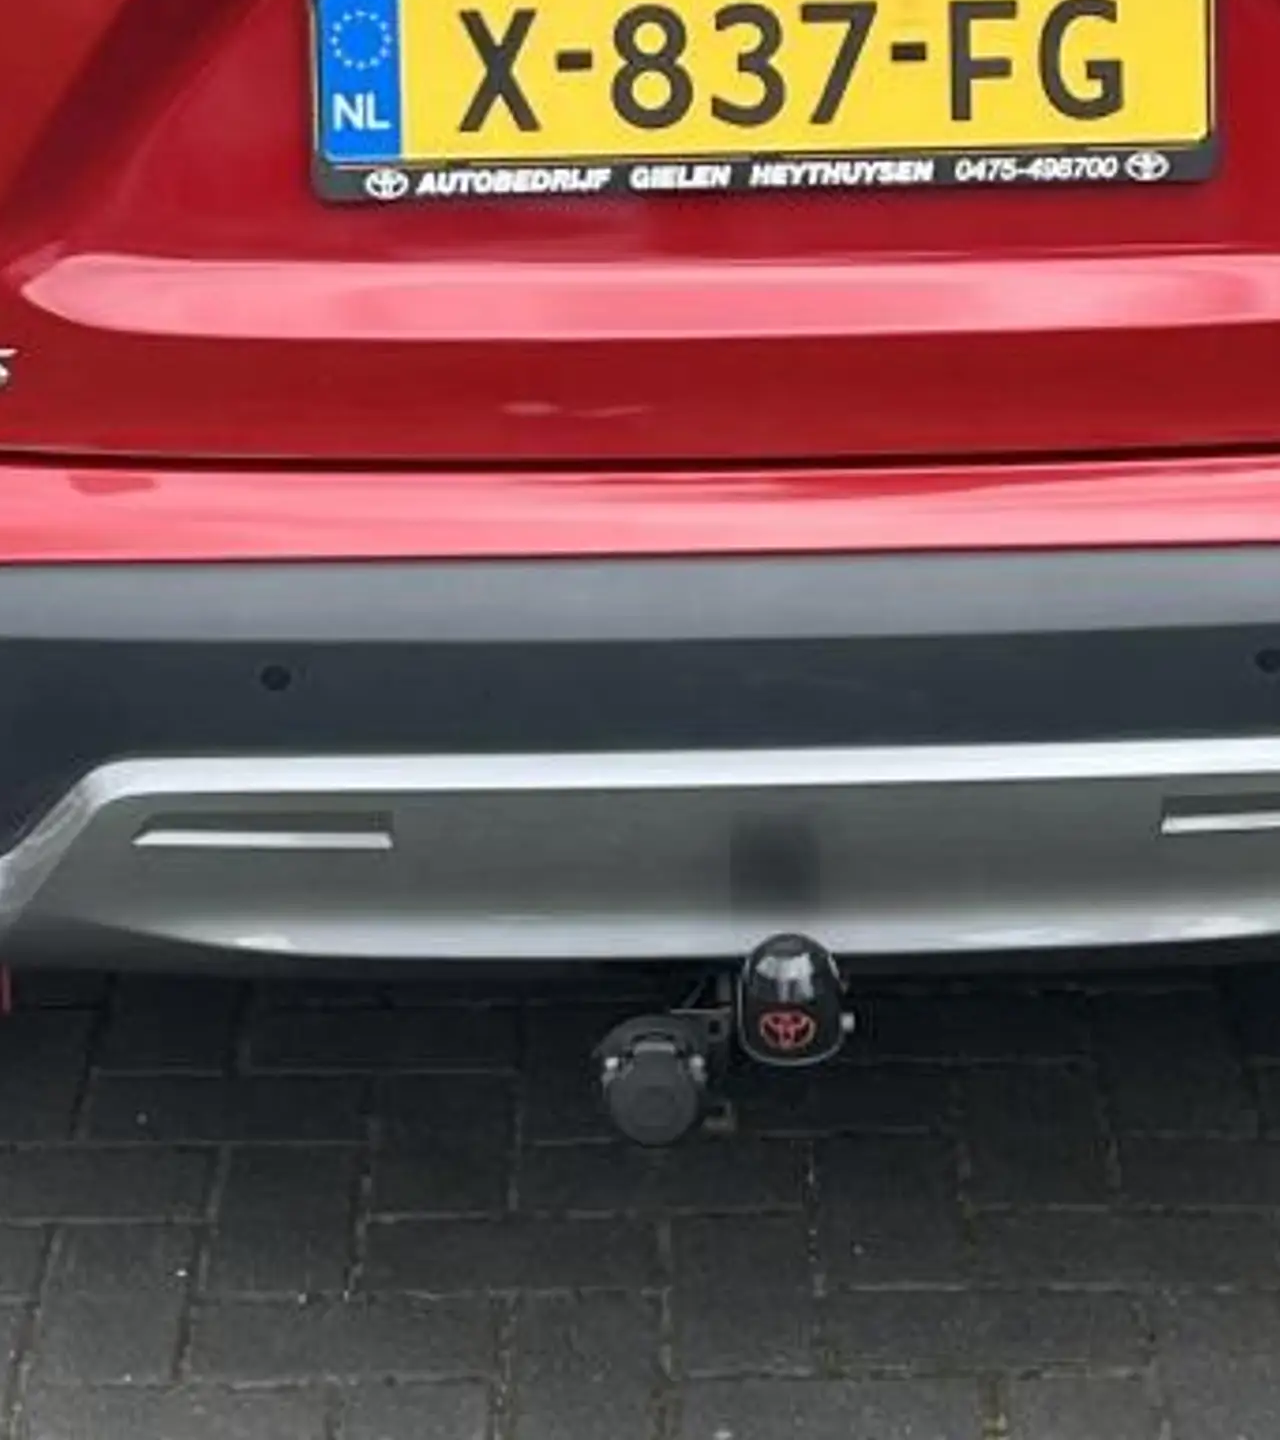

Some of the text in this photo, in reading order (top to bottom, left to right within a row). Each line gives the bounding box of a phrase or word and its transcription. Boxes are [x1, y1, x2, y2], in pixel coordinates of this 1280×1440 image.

[333, 94, 389, 131] NL
[415, 167, 611, 196] AUTOBEDRIJF
[628, 164, 733, 190] GIELEN
[749, 160, 935, 186] HEYTHUYSEN
